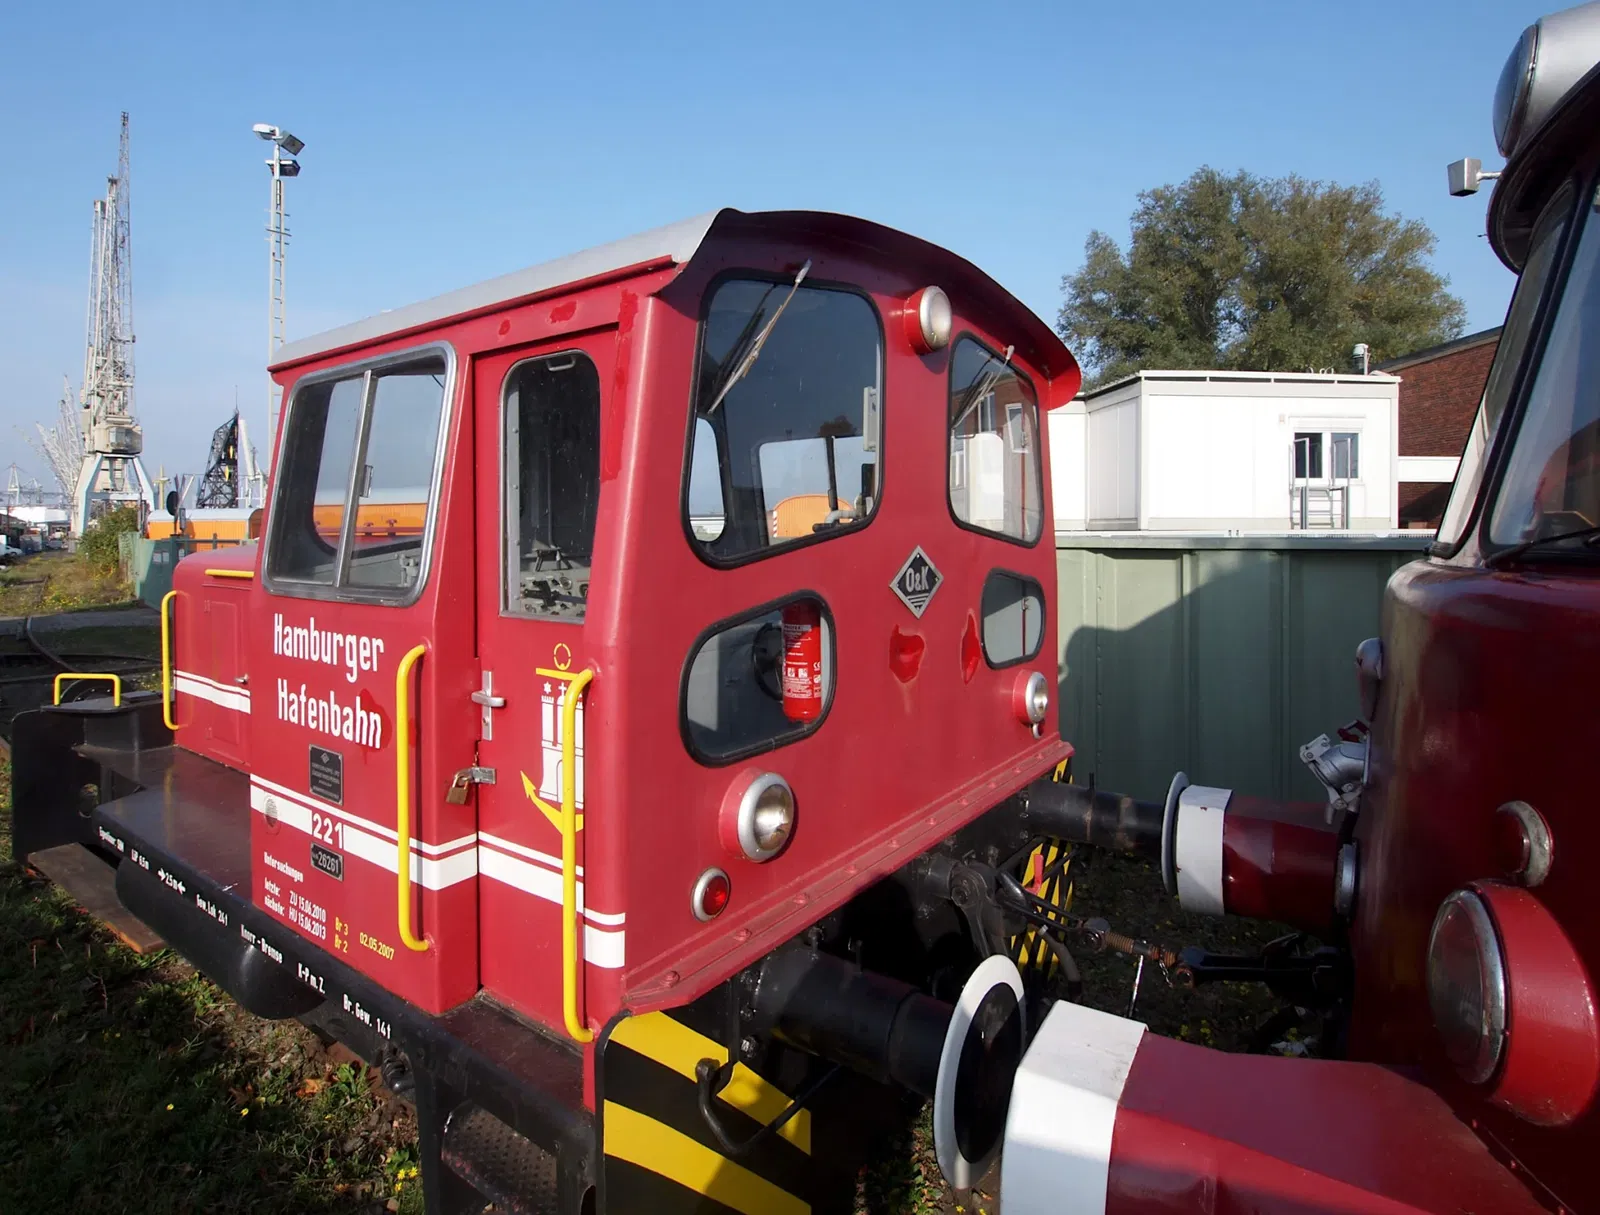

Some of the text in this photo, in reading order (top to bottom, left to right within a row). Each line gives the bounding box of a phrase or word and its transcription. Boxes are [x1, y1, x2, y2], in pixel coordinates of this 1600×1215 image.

[905, 566, 929, 593] O&K
[274, 613, 384, 683] Hamburger
[277, 678, 382, 749] Hafenbahn
[312, 813, 343, 849] 221
[264, 851, 304, 882] Untersuchungen
[318, 851, 339, 874] 26261
[289, 890, 298, 906] ZU
[298, 895, 327, 924] 15.06.2010
[289, 906, 298, 923] HU
[298, 911, 327, 940] 15.06.2013
[335, 916, 349, 936] Br 3
[261, 937, 283, 964] Bremse
[334, 934, 348, 953] Br 2
[359, 932, 395, 961] 02.05.2007
